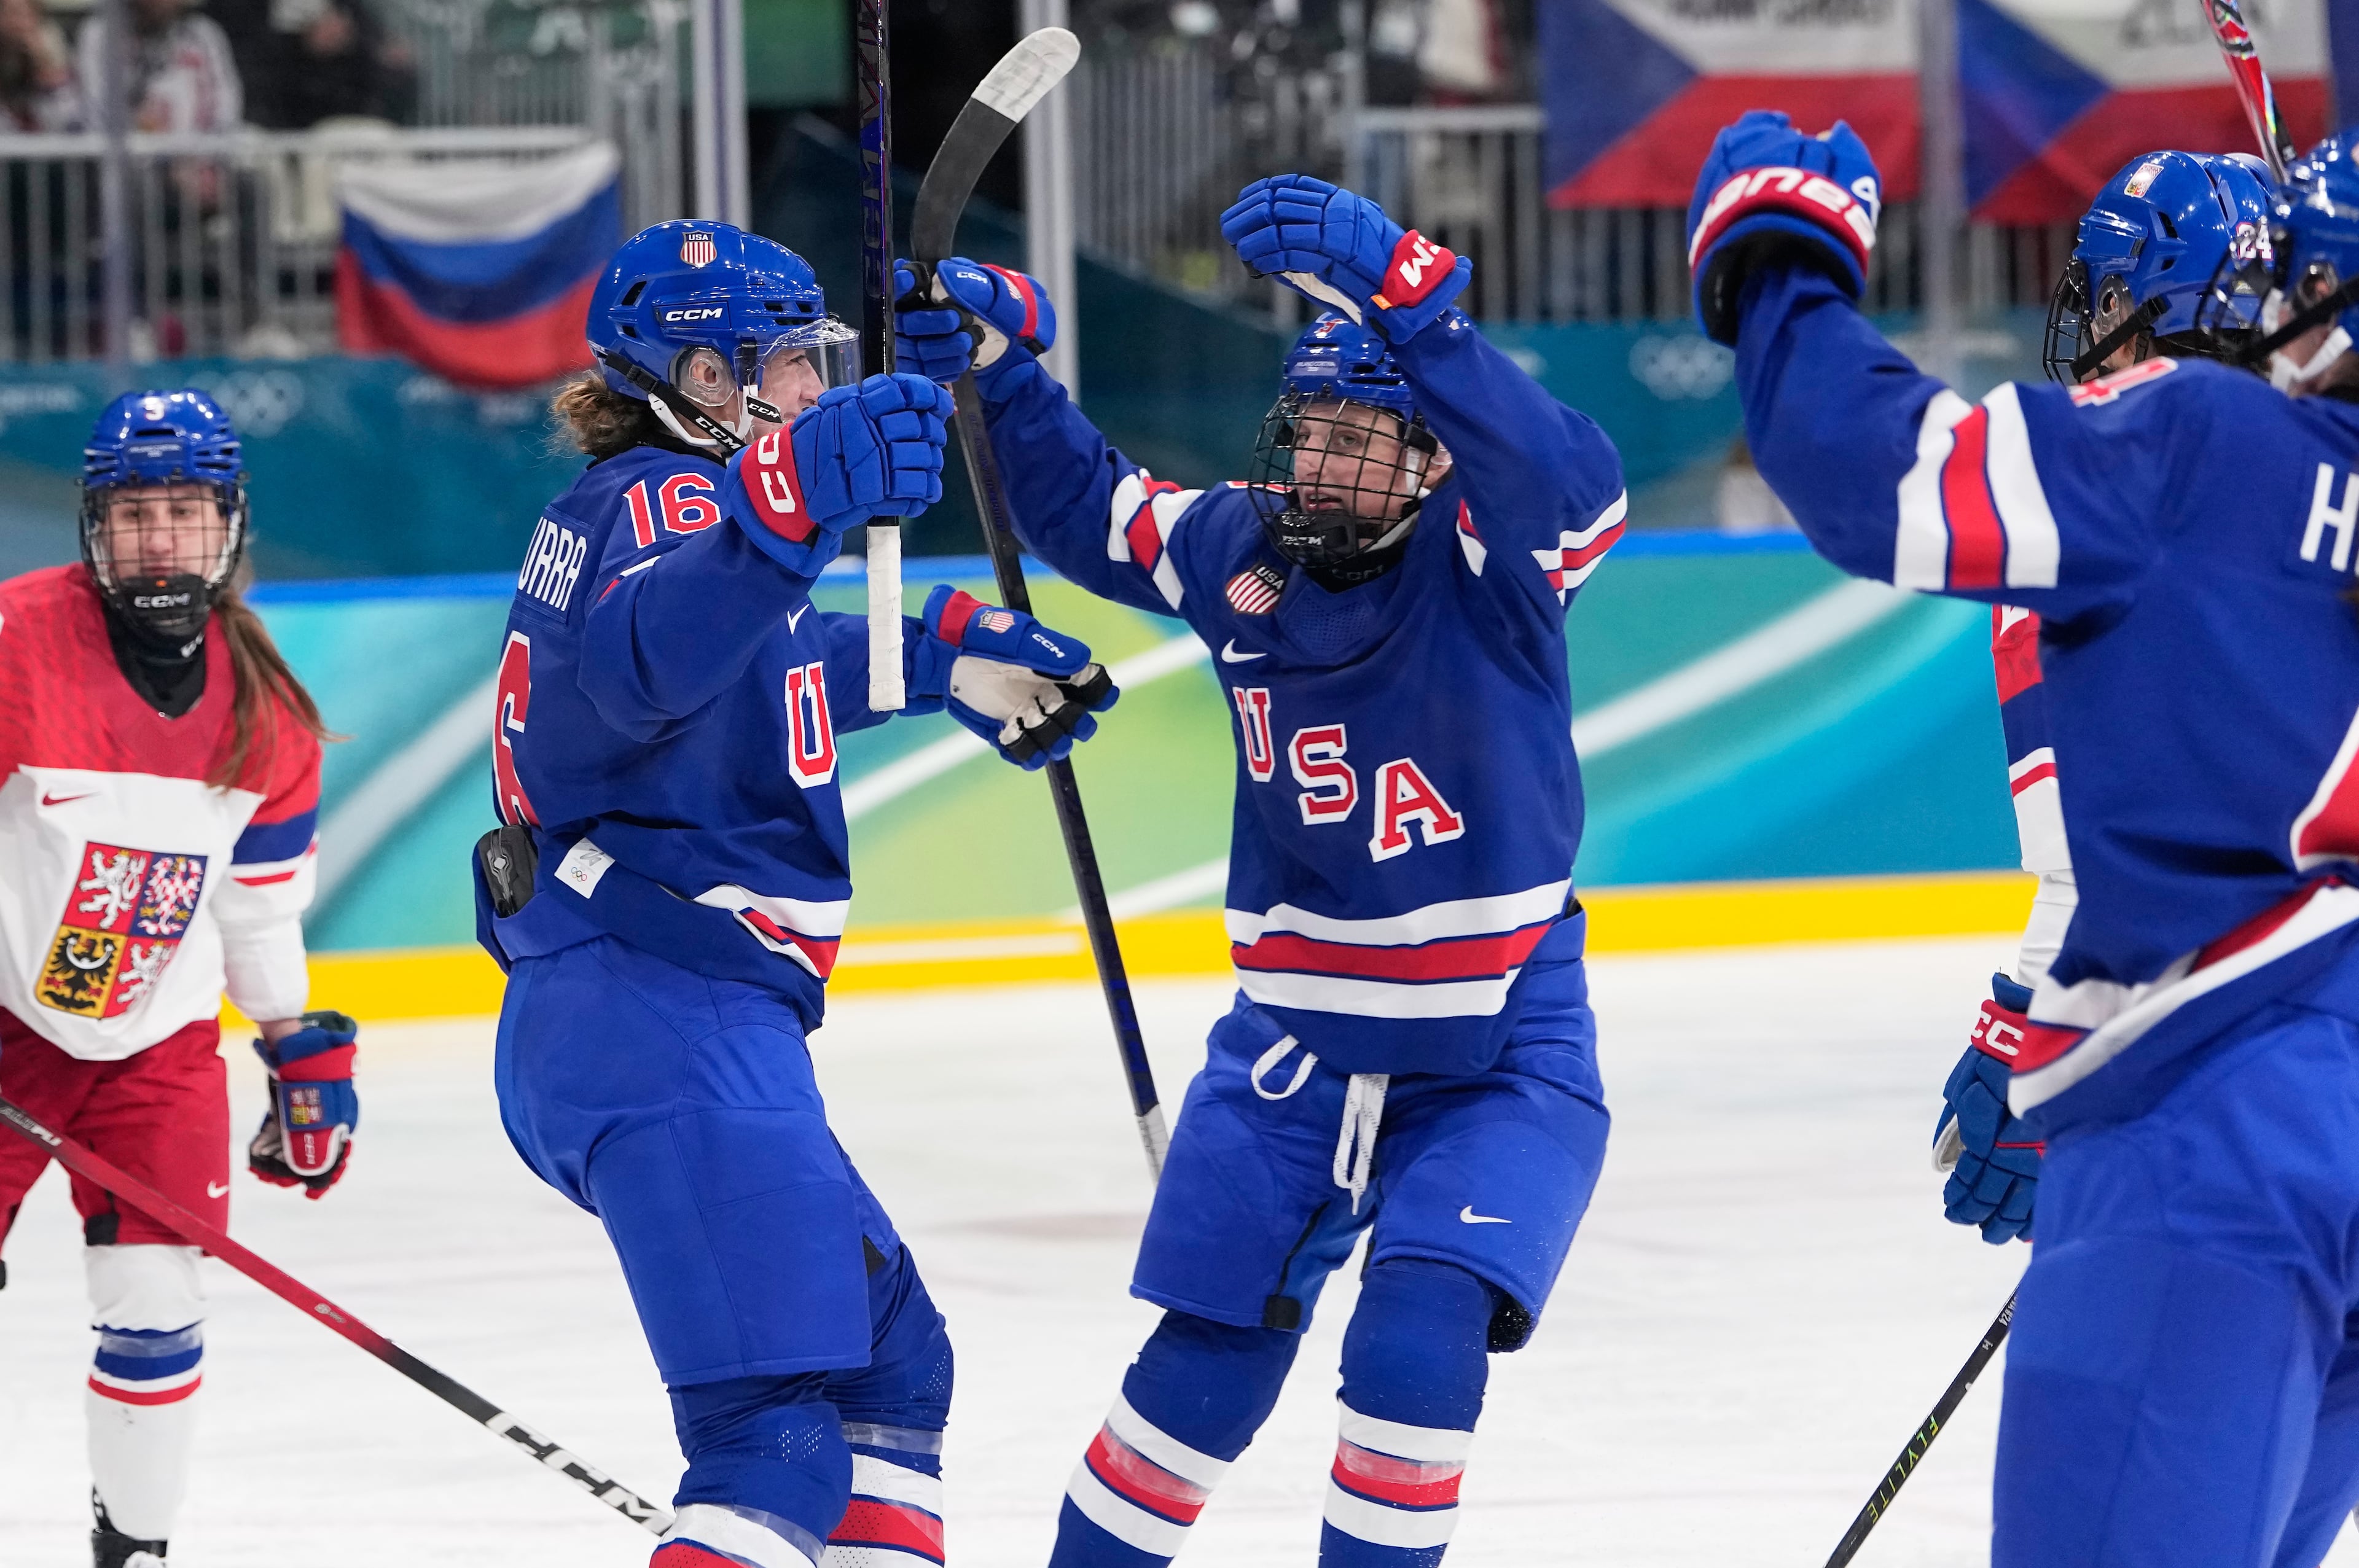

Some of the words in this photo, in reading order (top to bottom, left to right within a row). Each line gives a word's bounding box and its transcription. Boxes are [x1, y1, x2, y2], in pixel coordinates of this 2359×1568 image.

[2236, 222, 2274, 261] 24
[957, 271, 988, 284] CCM
[665, 308, 723, 322] CCM
[748, 402, 781, 419] CCM
[695, 415, 743, 450] CCM
[622, 472, 722, 549] 16
[2300, 462, 2359, 577] H
[1256, 566, 1285, 590] USA
[1031, 633, 1066, 659] CCM
[1232, 686, 1466, 863] USA
[485, 1412, 676, 1537] CCM
[1866, 1414, 1939, 1525] FLYLITE
